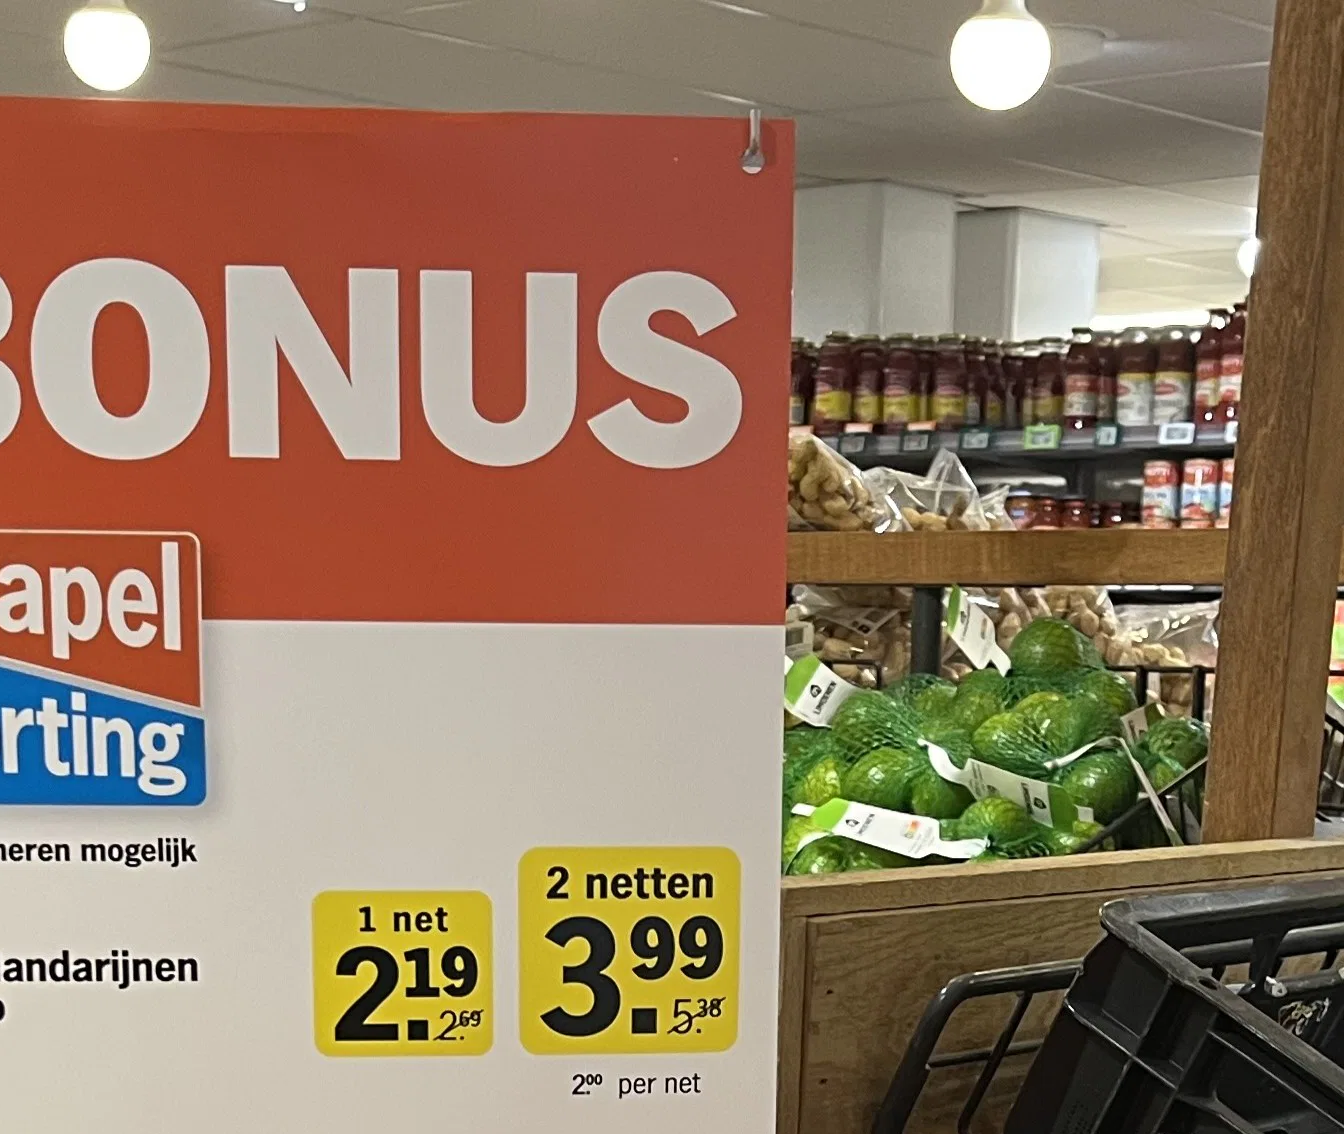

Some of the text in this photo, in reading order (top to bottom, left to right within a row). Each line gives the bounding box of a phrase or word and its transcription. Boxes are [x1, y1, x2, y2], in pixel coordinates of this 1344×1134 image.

[81, 838, 198, 868] mogelijk
[546, 866, 714, 899] 2 netten
[358, 906, 449, 932] 1 net
[539, 915, 724, 1037] 3.99
[334, 946, 479, 1041] 2.19
[572, 1072, 701, 1100] 2.00 per net
